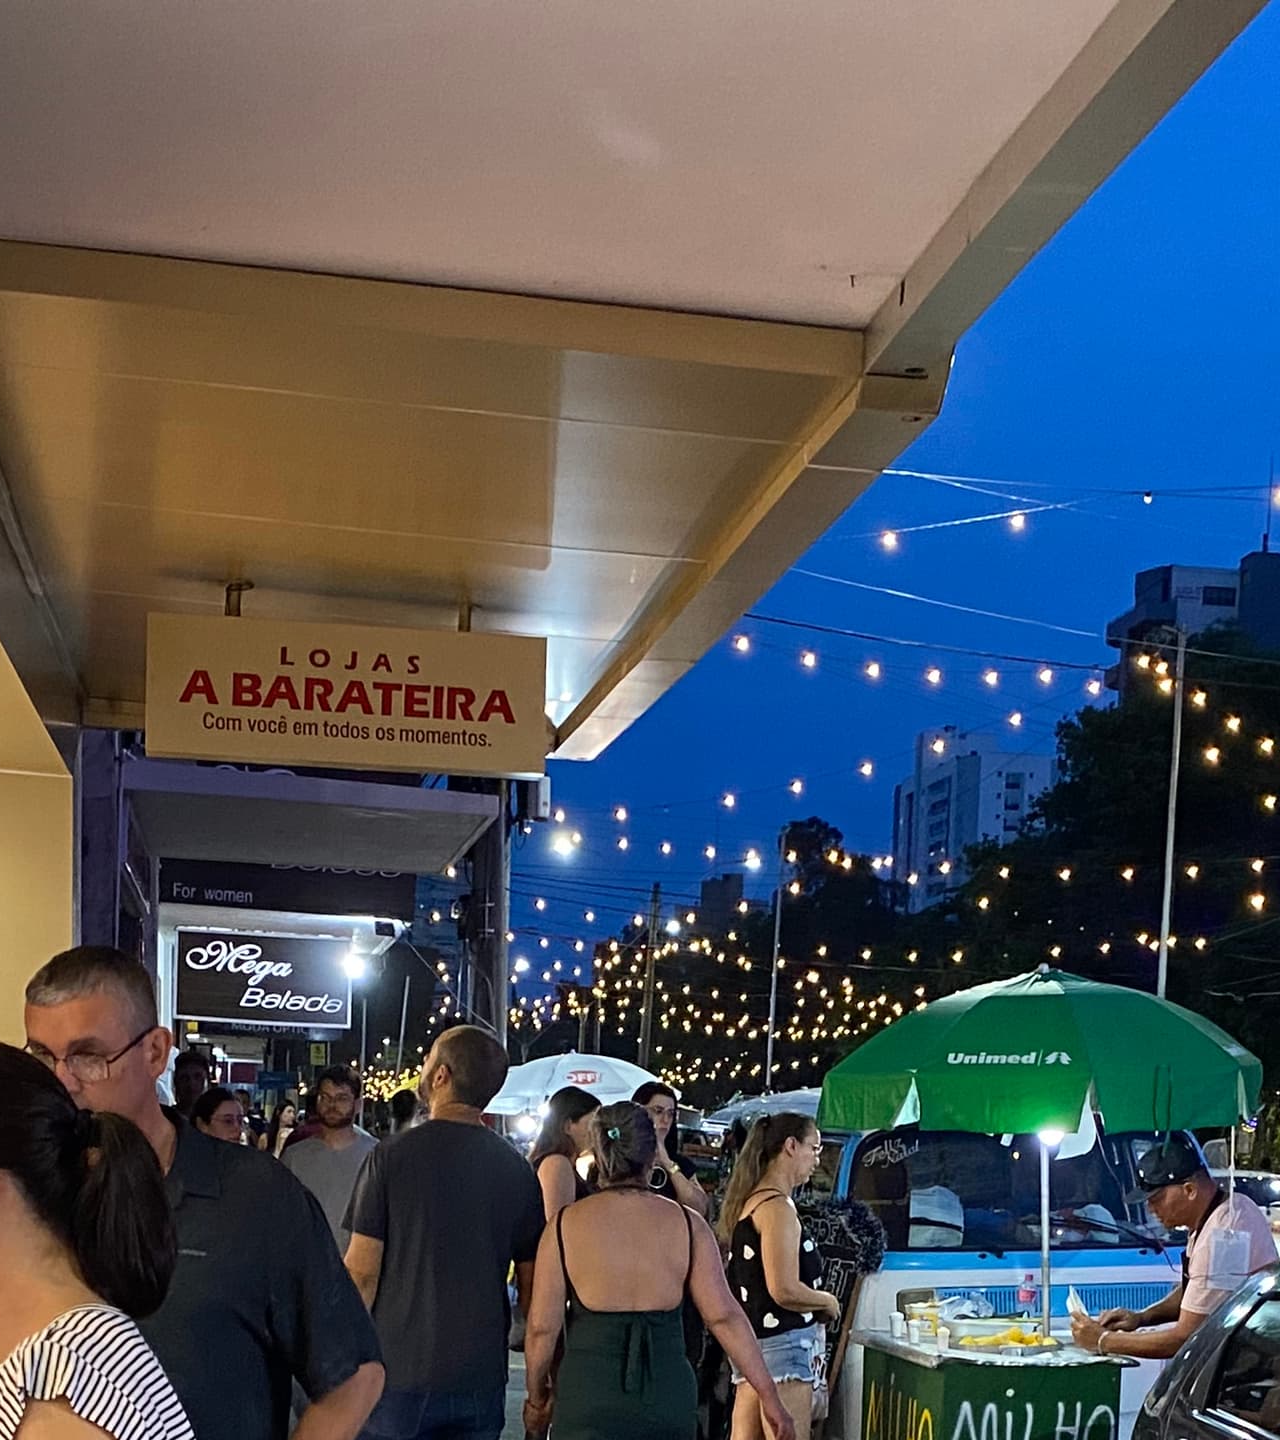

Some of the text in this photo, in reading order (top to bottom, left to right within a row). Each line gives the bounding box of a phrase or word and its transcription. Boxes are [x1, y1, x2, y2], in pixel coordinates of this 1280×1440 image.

[279, 646, 421, 675] LOJAS
[179, 669, 516, 724] A BARATEIRA
[202, 711, 493, 747] Com você em todos os momentos.
[173, 883, 253, 904] For women
[186, 941, 293, 985] Mega
[240, 988, 343, 1013] Balada
[947, 1051, 1037, 1064] Unimed
